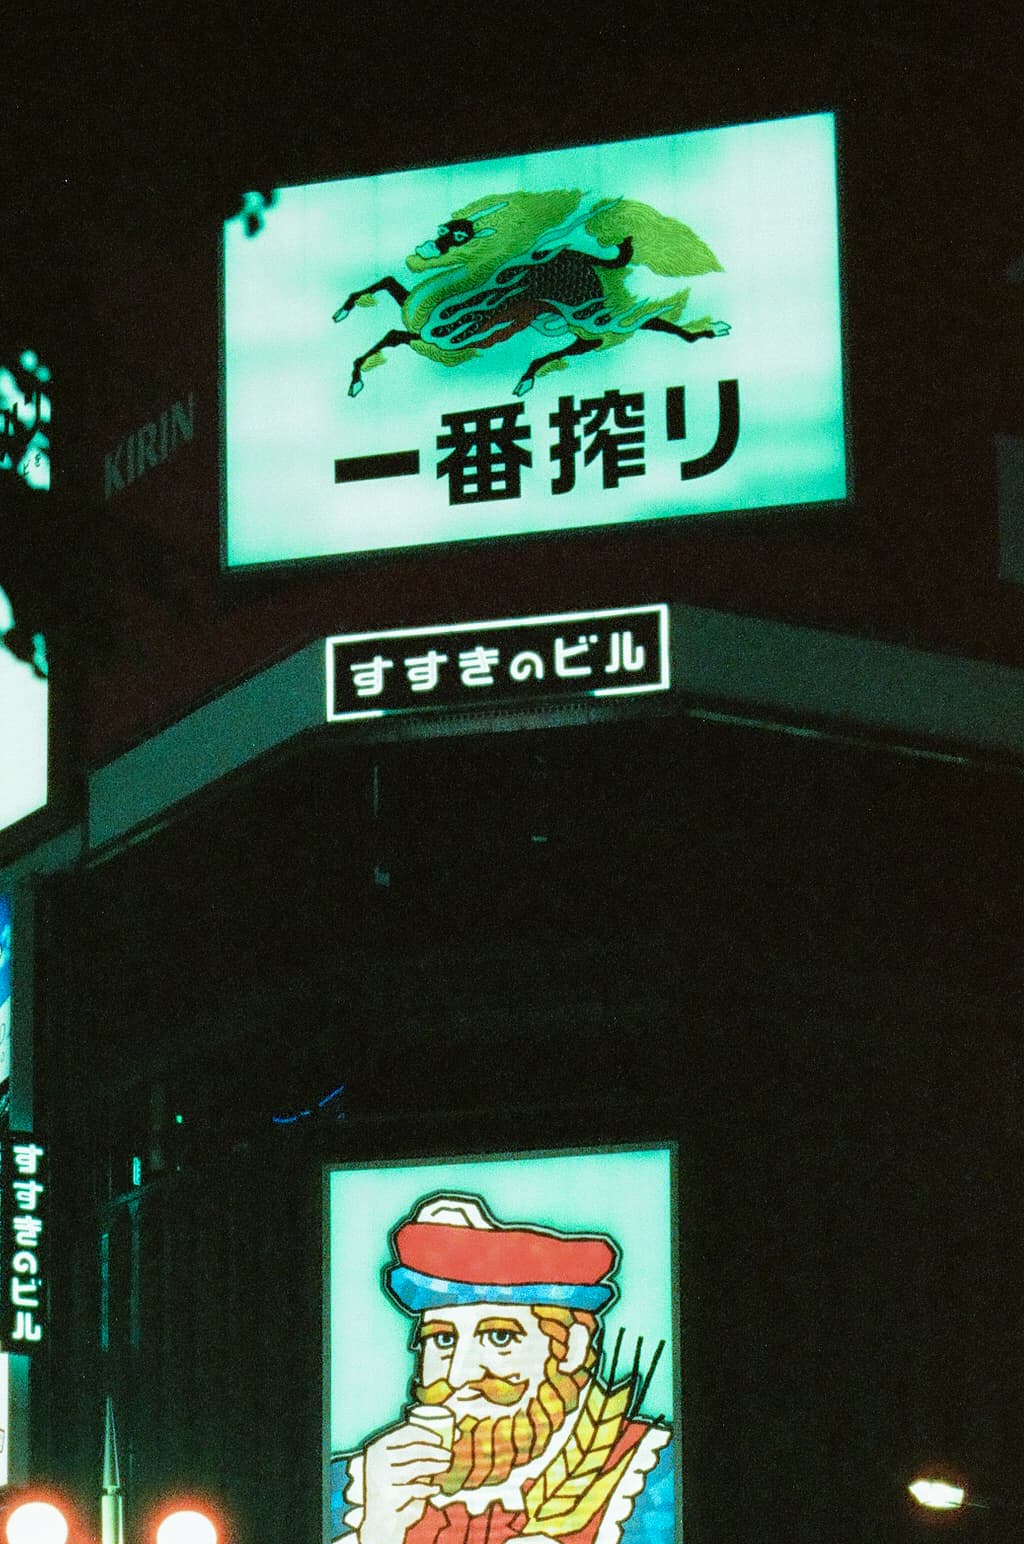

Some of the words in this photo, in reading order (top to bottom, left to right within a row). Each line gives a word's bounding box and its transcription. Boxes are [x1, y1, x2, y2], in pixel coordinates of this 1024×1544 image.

[101, 395, 197, 500] KIRIN
[334, 380, 741, 505] 一番搾り
[350, 631, 646, 697] すすきのビル
[12, 1144, 43, 1342] すすきのビル
